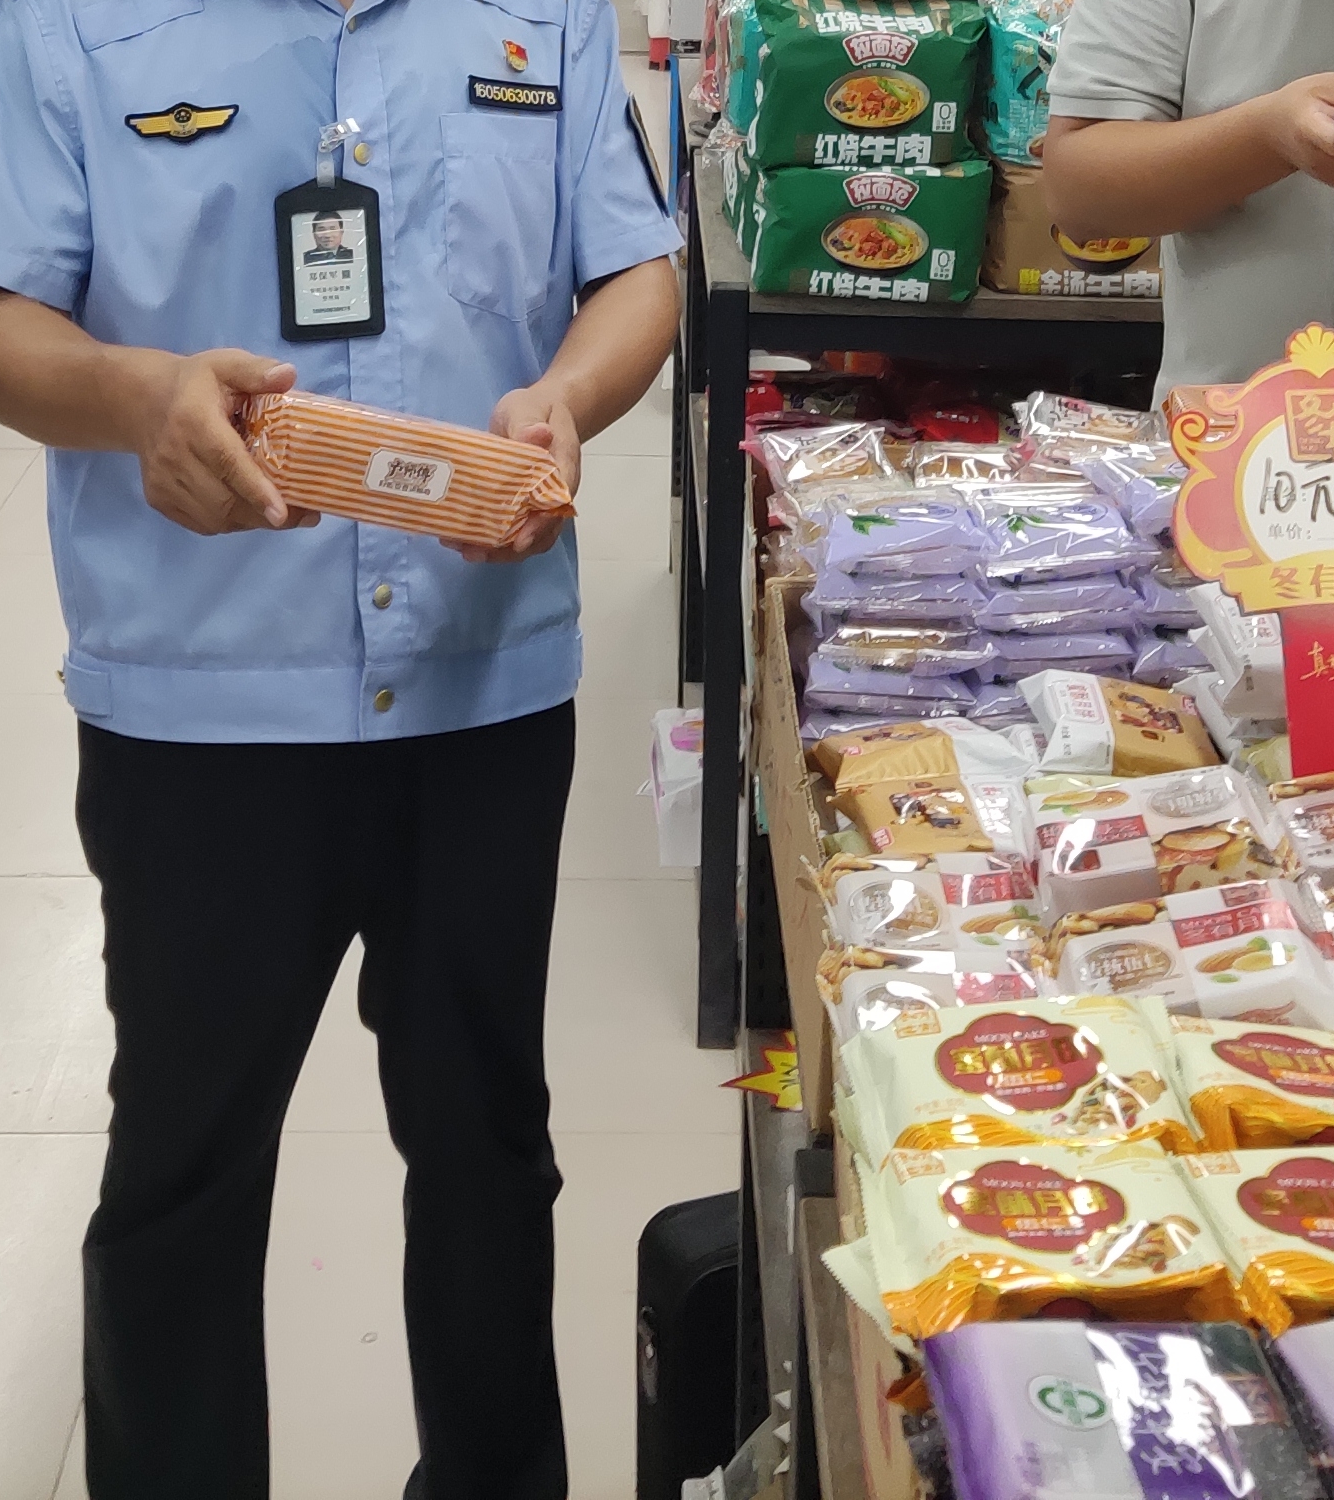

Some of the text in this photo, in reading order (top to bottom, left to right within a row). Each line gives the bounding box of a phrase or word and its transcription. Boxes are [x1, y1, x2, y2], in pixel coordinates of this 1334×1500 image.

[815, 11, 935, 34] 红烧牛肉
[474, 82, 557, 106] 16050630078
[814, 133, 933, 165] 红烧牛肉
[808, 269, 930, 303] 红烧牛肉
[1040, 269, 1161, 298] 金汤牛肉
